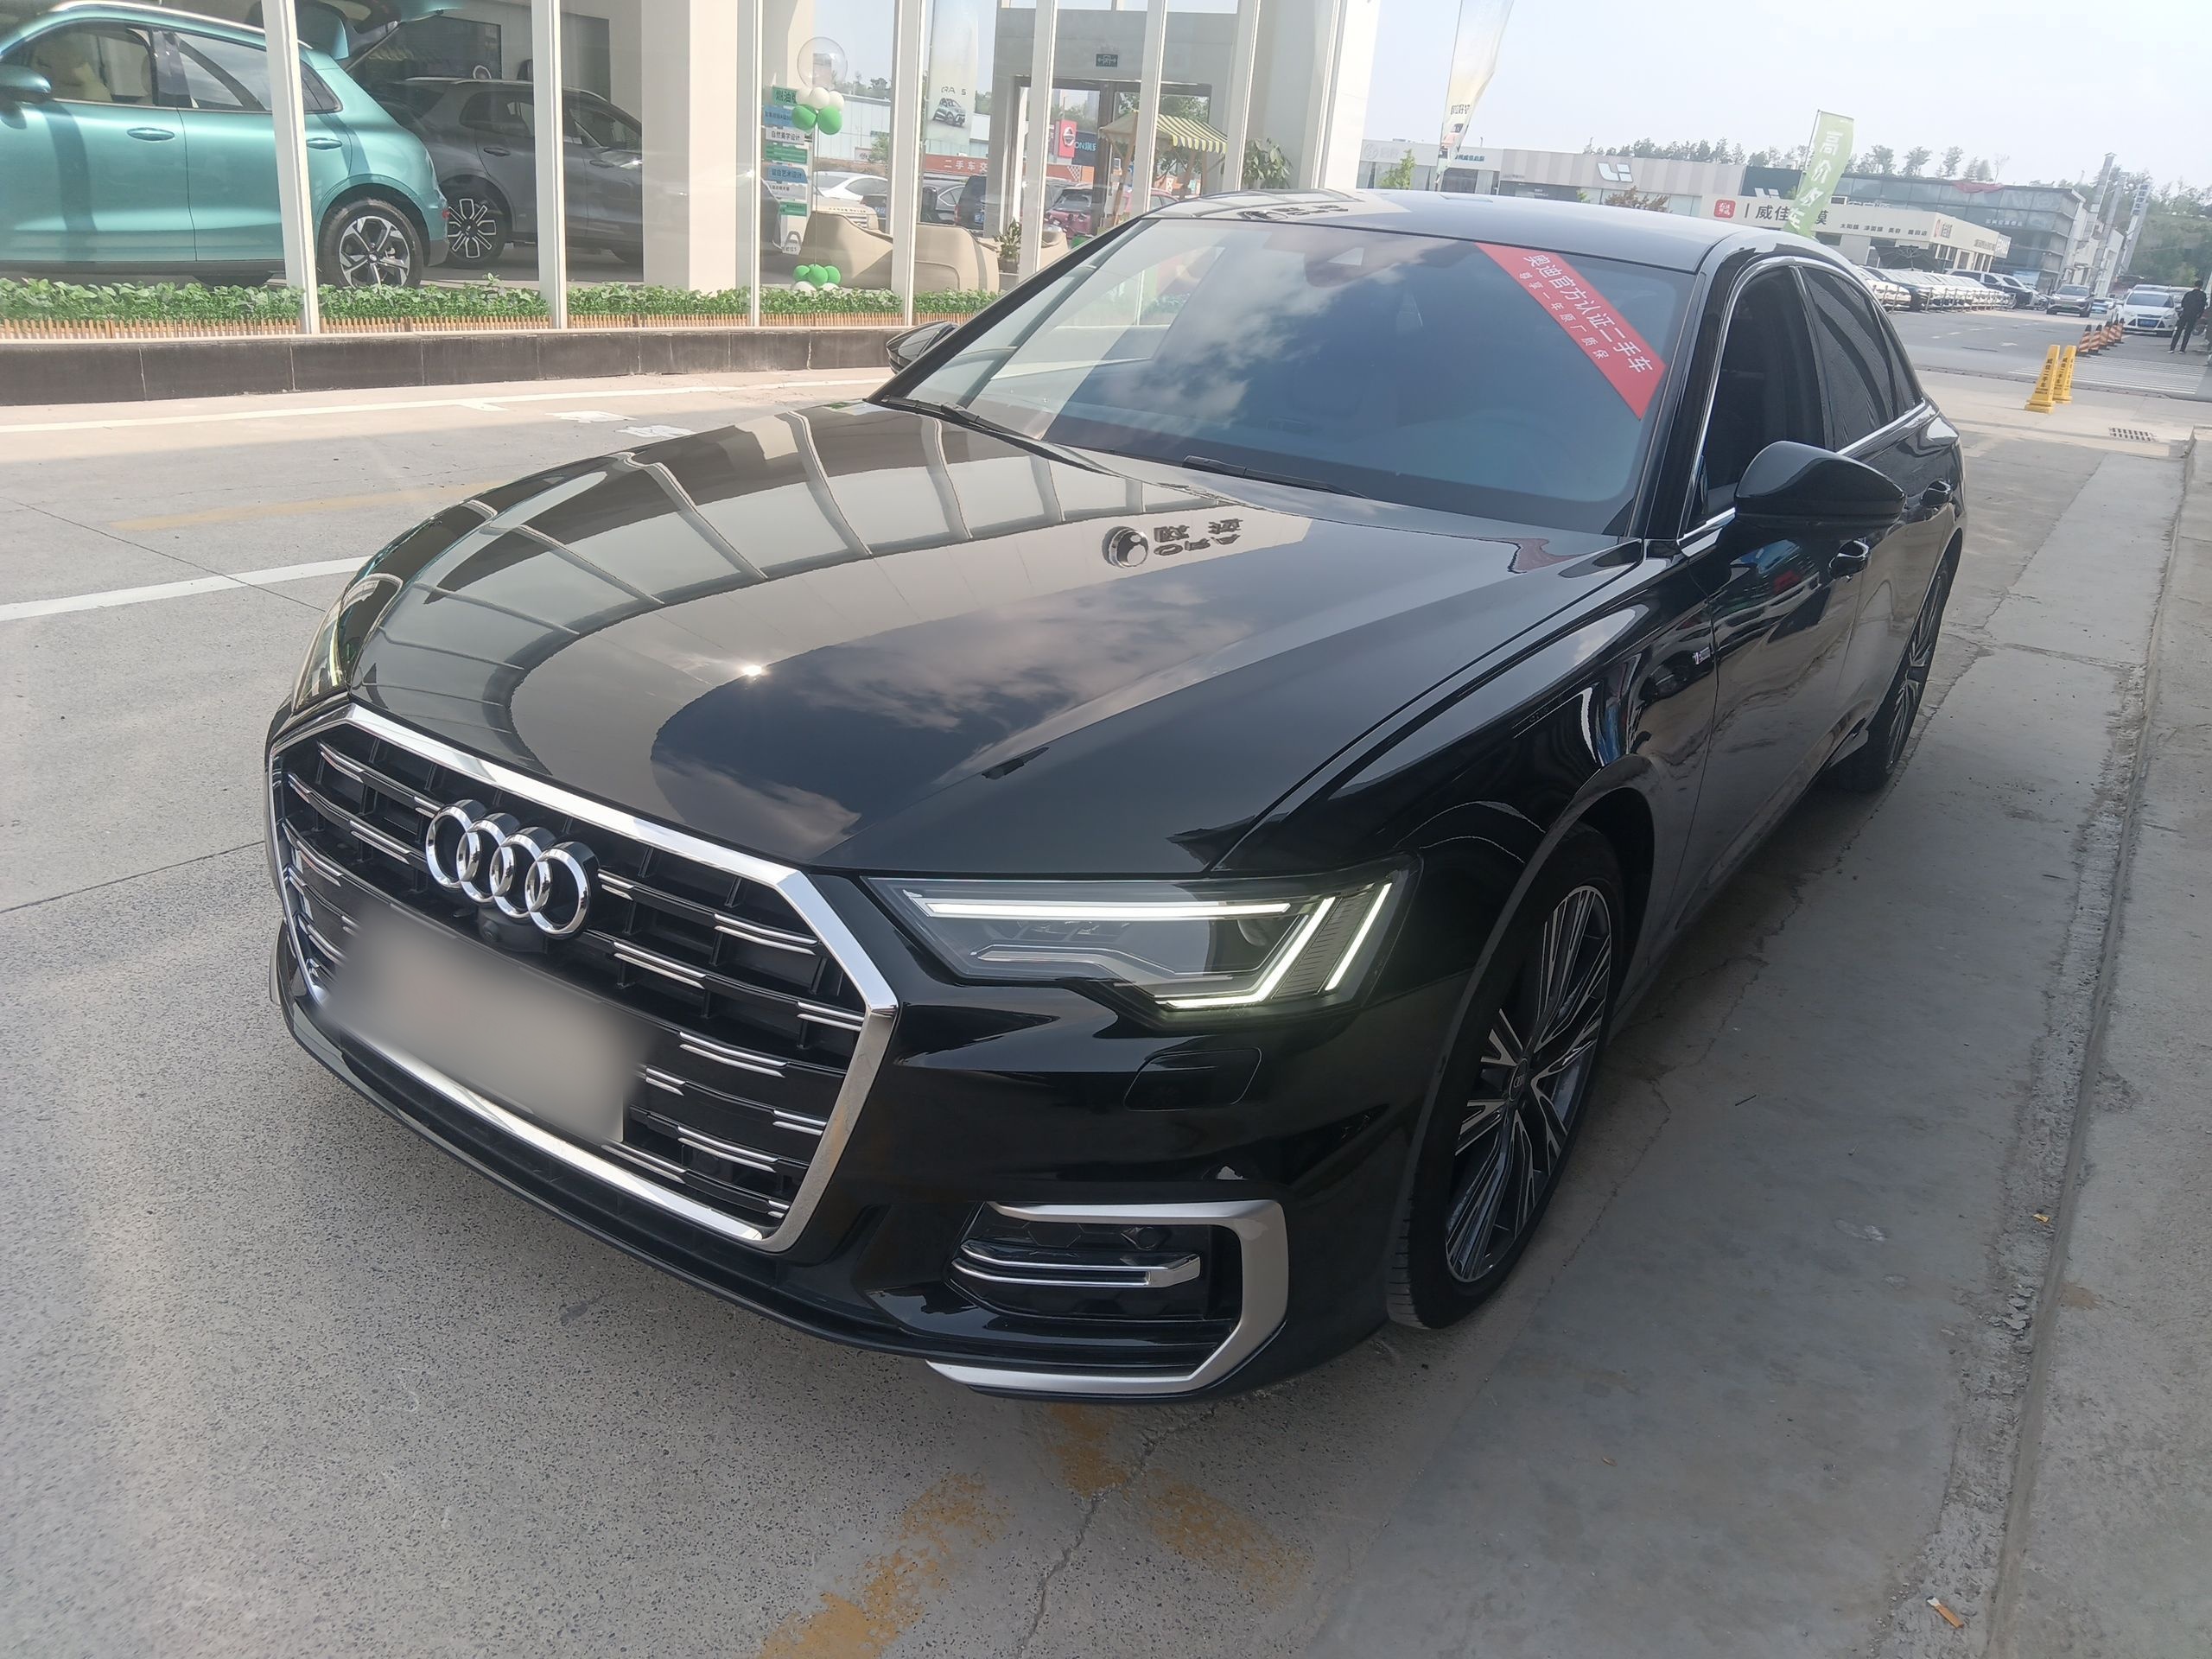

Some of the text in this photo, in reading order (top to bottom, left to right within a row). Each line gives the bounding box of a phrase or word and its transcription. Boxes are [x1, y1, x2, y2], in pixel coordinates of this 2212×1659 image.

[1755, 204, 1829, 226] 威佳膜
[1516, 270, 1610, 360] 尊享一年原厂质保
[1522, 253, 1654, 375] 奥迪官方认证二手车
